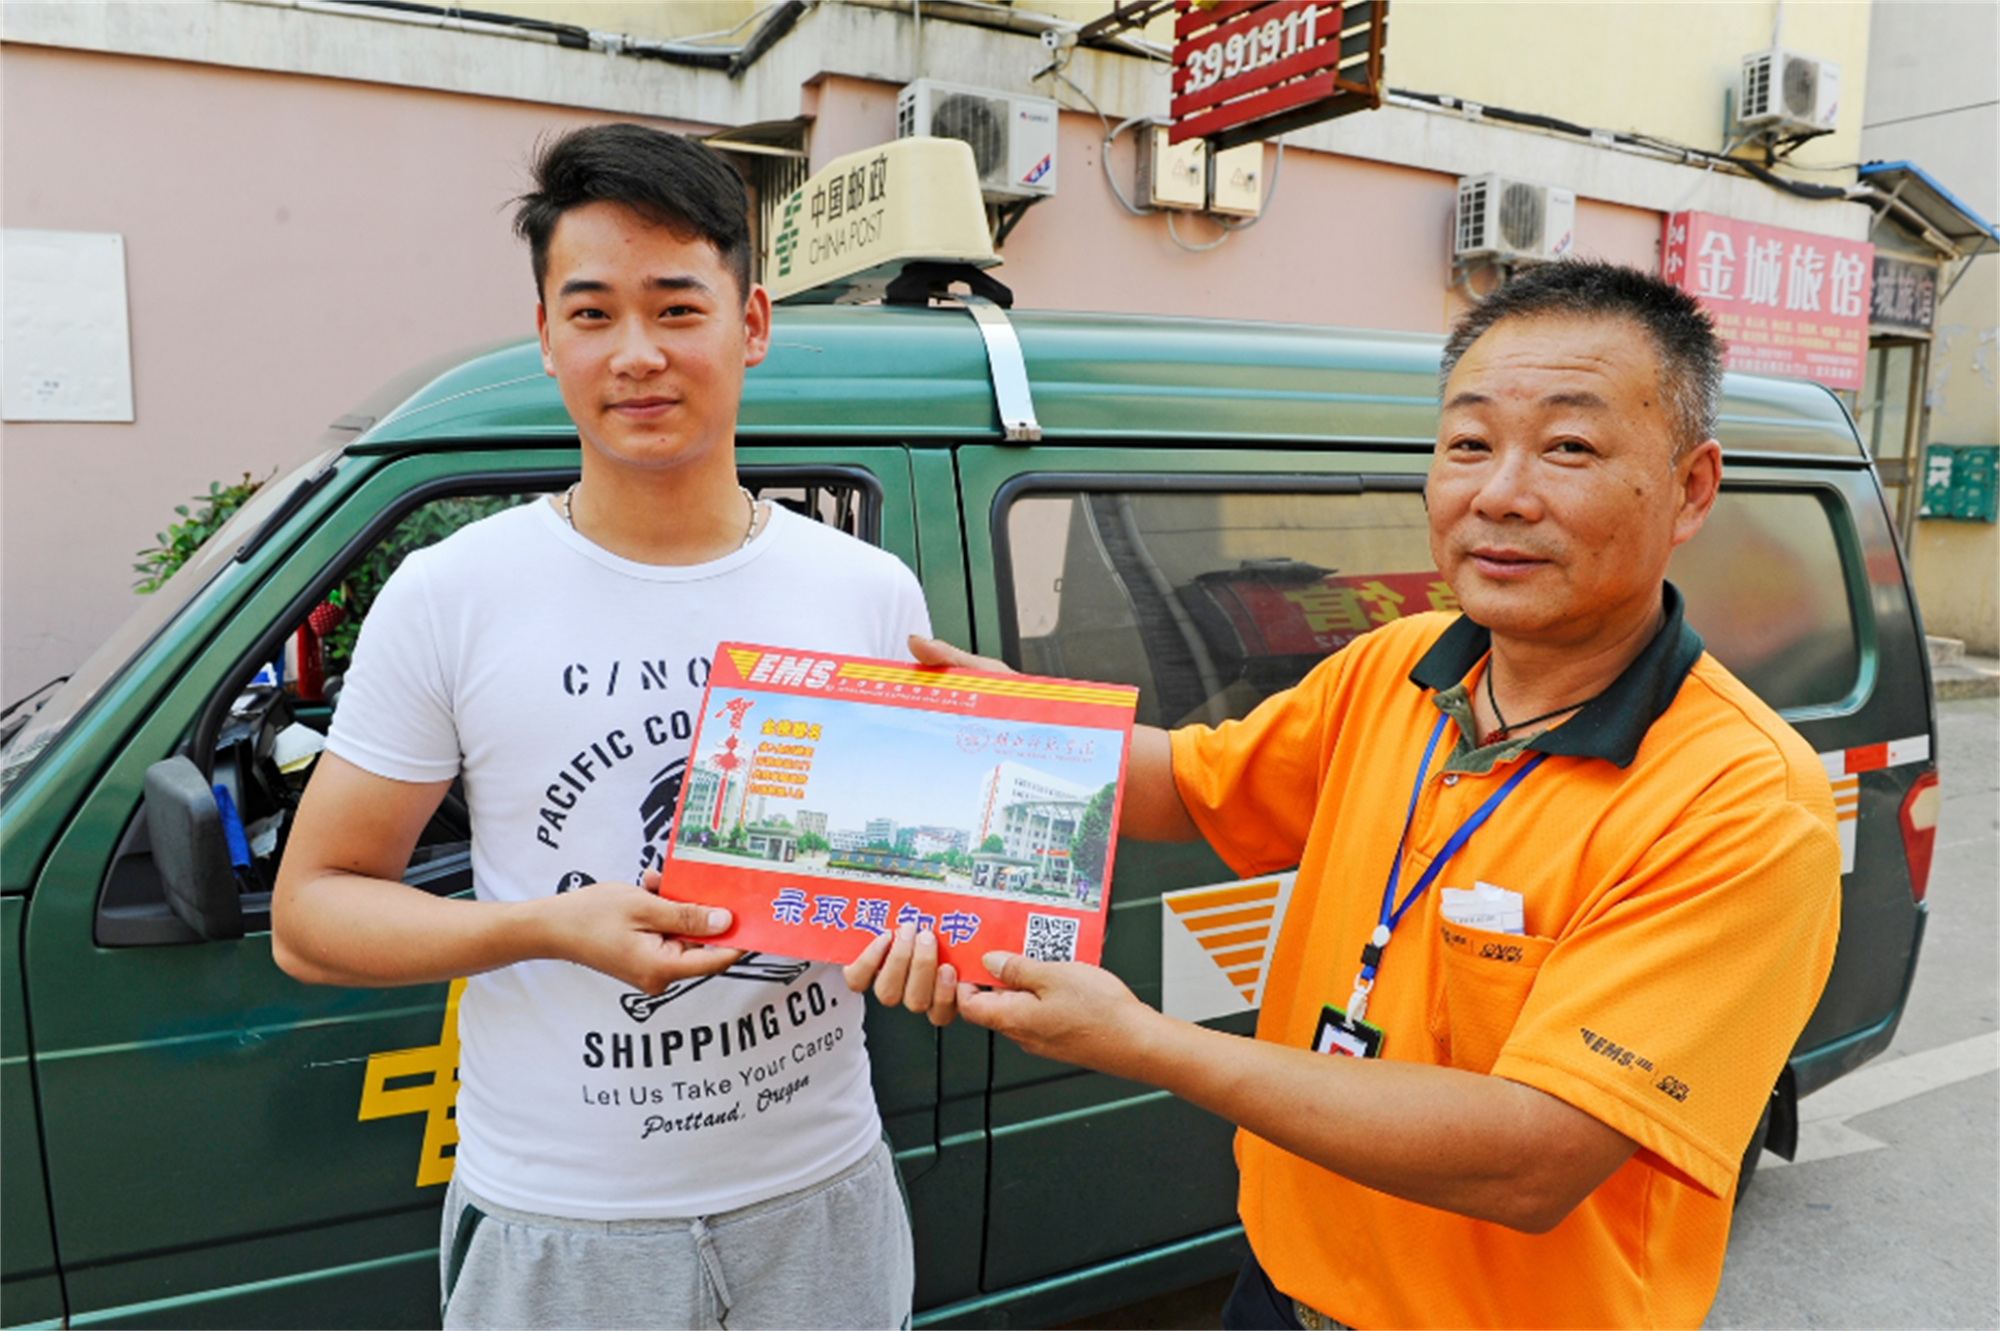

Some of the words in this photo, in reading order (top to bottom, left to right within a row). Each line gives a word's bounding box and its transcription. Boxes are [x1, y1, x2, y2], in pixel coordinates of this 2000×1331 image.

[1185, 4, 1317, 95] 3991911
[811, 152, 888, 229] 中国邮政
[809, 230, 846, 265] CHINA
[850, 209, 886, 247] POST
[1693, 230, 1866, 317] 金城旅馆
[749, 653, 837, 690] EMS
[714, 696, 755, 731] 贺
[537, 729, 633, 849] PACIFIC
[771, 887, 982, 947] 录取通知书
[583, 1003, 781, 1069] SHIPPING
[786, 981, 838, 1028] CO.
[582, 1084, 621, 1106] Let
[630, 1086, 663, 1106] Us
[671, 1078, 732, 1102] Take
[739, 1053, 786, 1087] Your
[791, 1025, 844, 1065] Cargo
[756, 1074, 811, 1113] Oregon
